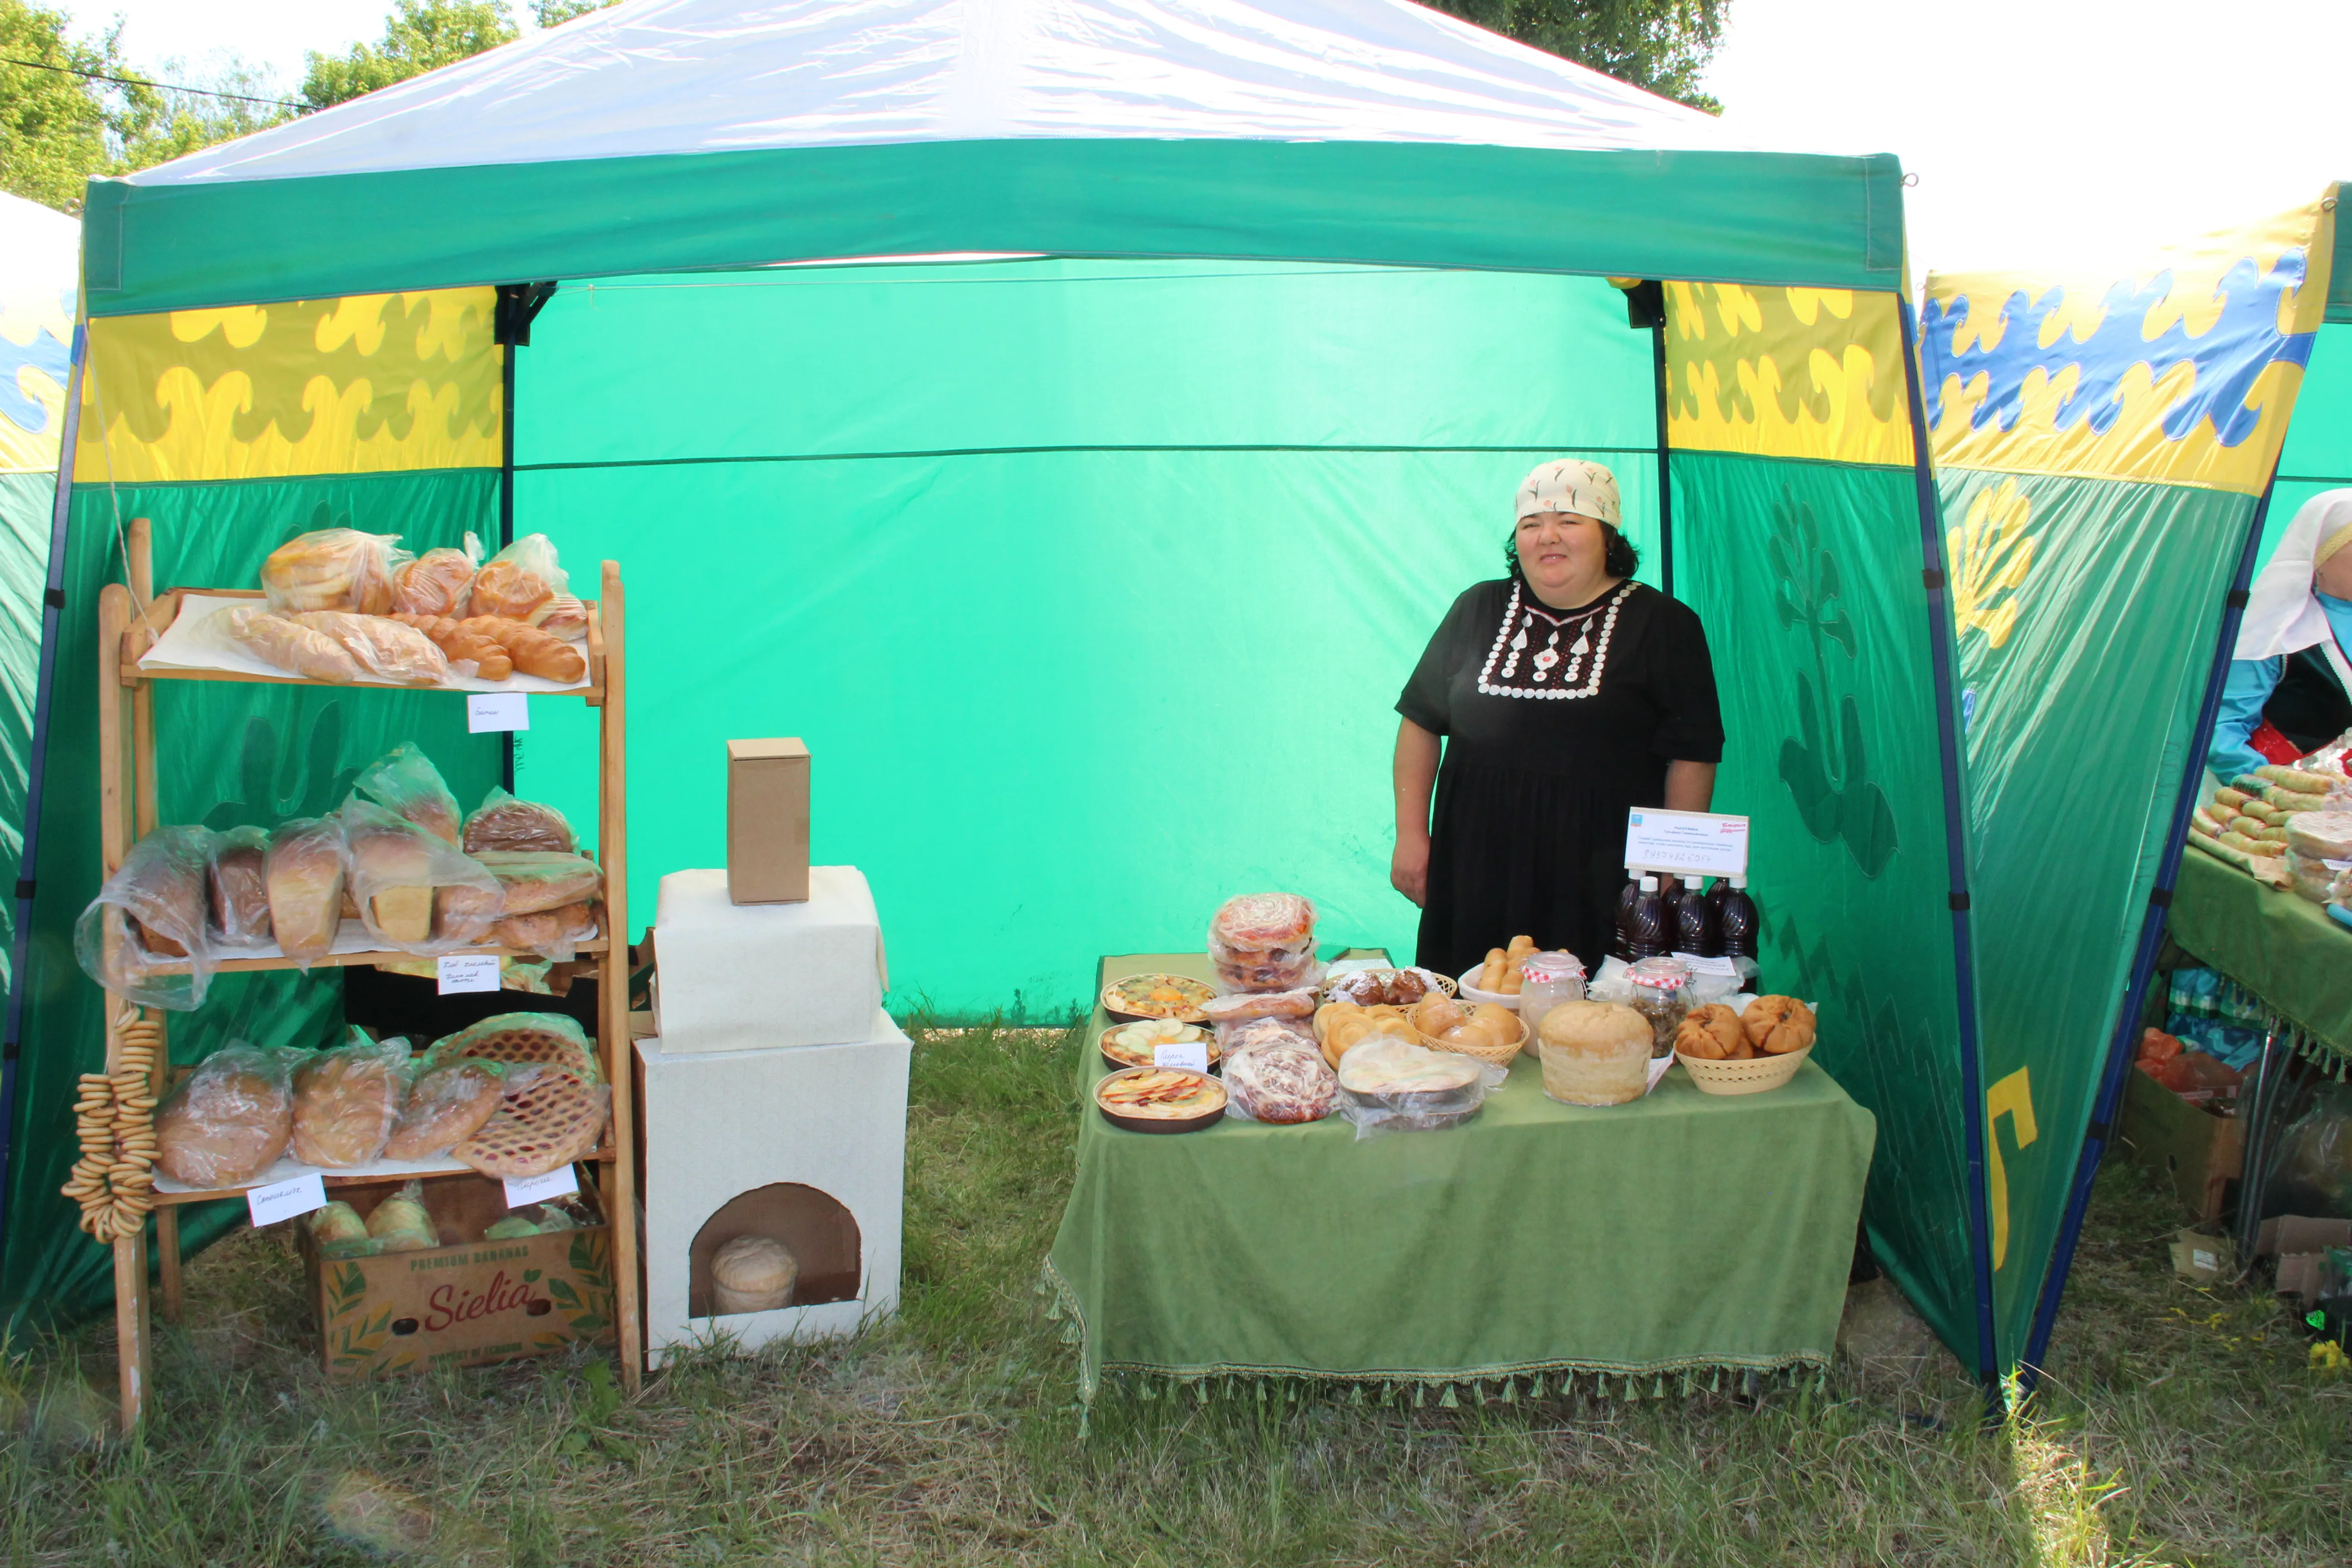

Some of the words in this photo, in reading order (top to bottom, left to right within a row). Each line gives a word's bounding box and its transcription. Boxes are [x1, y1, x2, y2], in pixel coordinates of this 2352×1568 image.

[410, 1253, 468, 1271] PREMIUM
[474, 1245, 529, 1264] BANANAS
[425, 1270, 537, 1332] Sielia
